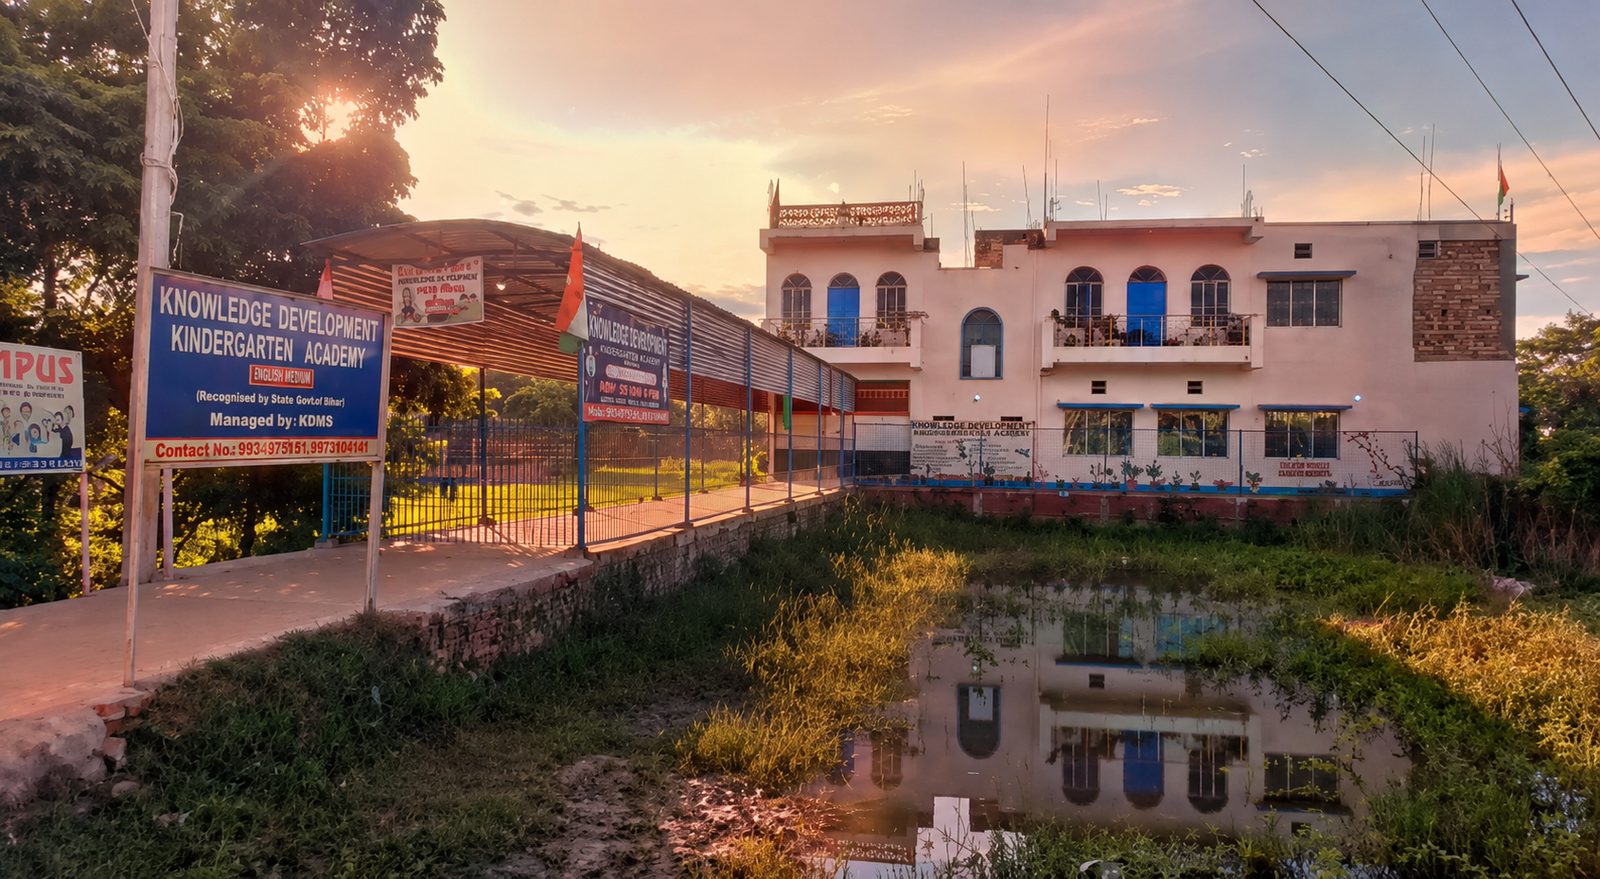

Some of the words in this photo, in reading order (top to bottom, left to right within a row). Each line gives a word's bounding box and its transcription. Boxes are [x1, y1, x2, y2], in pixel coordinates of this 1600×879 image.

[159, 286, 272, 328] KNOWLEDGE
[278, 305, 379, 342] DEVELOPMENT
[171, 324, 293, 362] KINDERGARTEN
[304, 341, 366, 368] ACADEMY
[254, 367, 283, 382] ENGLISH
[196, 390, 256, 406] (Recognised
[258, 392, 269, 405] by
[271, 393, 294, 405] State
[210, 412, 274, 430] Managed
[299, 414, 333, 428] KDMS
[155, 442, 210, 458] Contact
